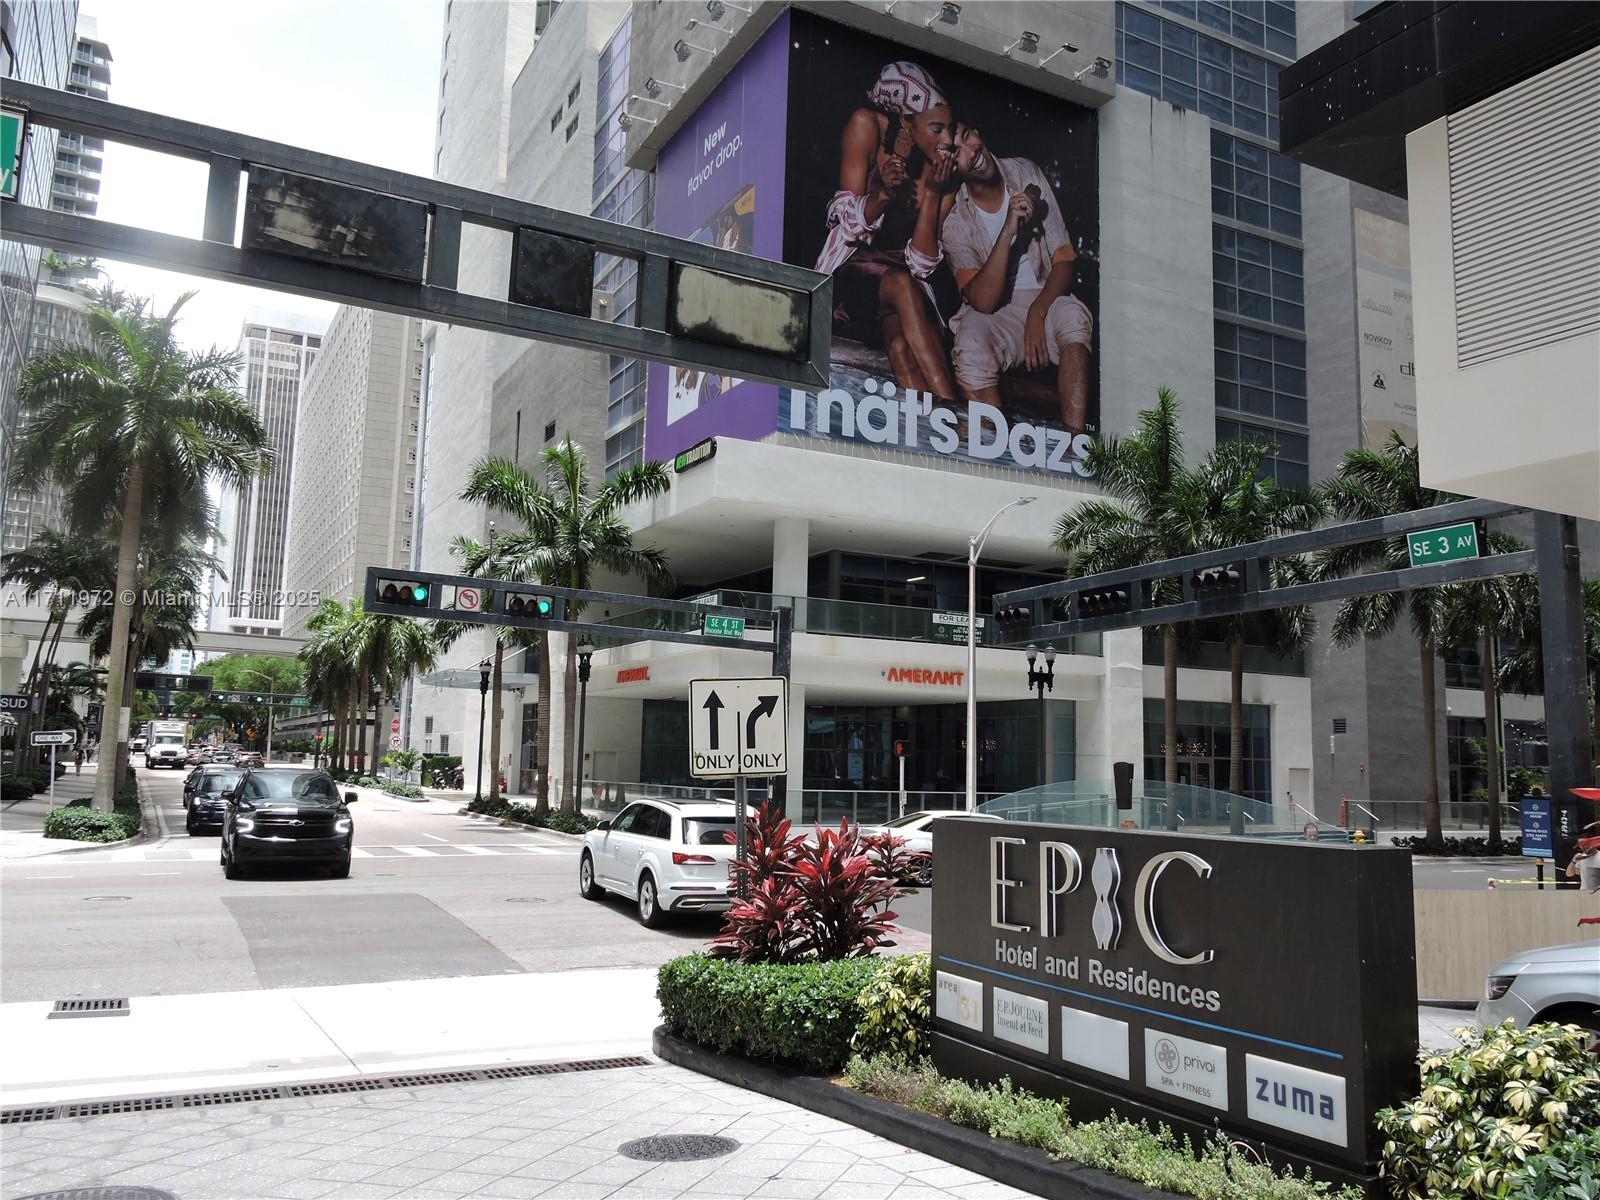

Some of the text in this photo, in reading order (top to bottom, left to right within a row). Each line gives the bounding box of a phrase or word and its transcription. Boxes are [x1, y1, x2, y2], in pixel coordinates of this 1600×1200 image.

[703, 121, 727, 156] New
[687, 134, 743, 197] flavor drop.
[1363, 332, 1392, 346] NOVIKOV
[968, 400, 1096, 478] Dazs
[1412, 535, 1472, 557] SE 3 AV
[711, 618, 739, 630] SE 4 ST
[886, 667, 965, 687] AMERANT
[0, 697, 28, 709] SUD
[695, 753, 782, 769] ONLY ONLY
[990, 836, 1215, 966] EPIC
[938, 979, 959, 993] area
[995, 938, 1222, 1013] Hotel and Residences
[960, 995, 979, 1025] 31
[1020, 1021, 1027, 1033] et
[1184, 1055, 1216, 1074] privai
[1161, 1075, 1174, 1088] SPA
[1182, 1083, 1212, 1098] FITNESS
[1255, 1077, 1335, 1121] zuma
